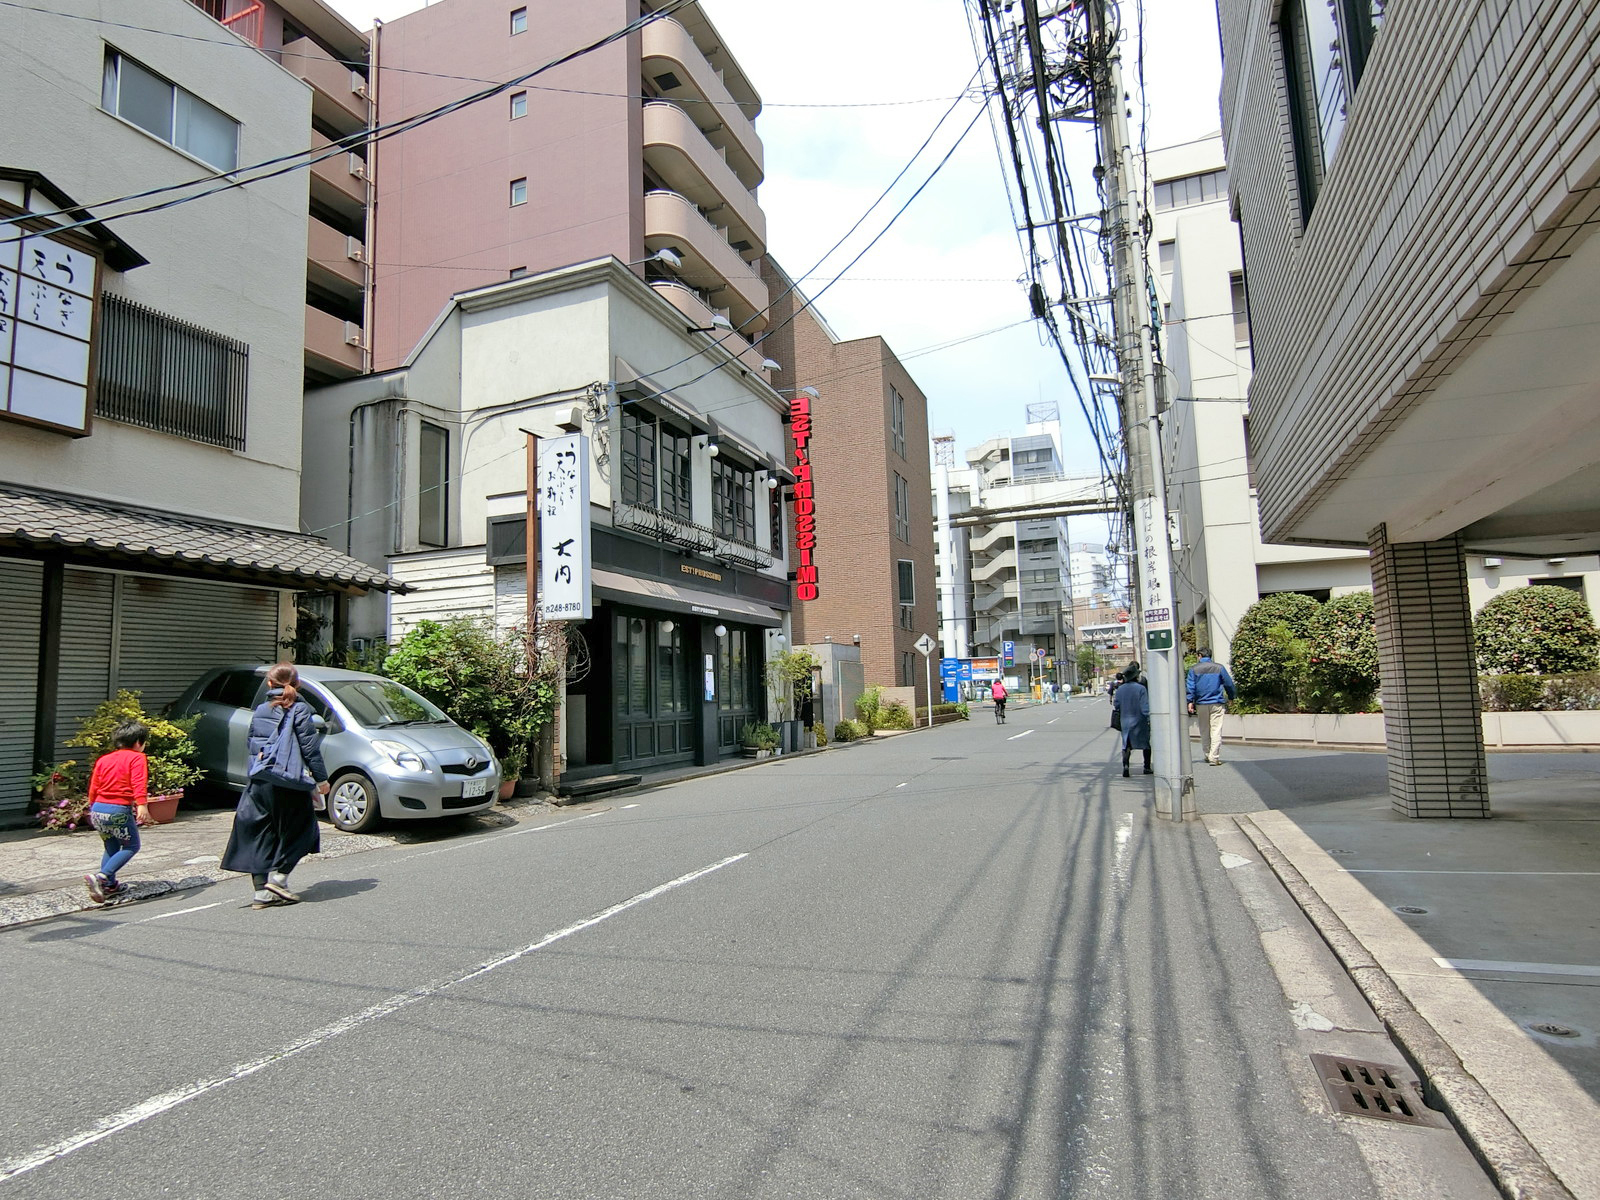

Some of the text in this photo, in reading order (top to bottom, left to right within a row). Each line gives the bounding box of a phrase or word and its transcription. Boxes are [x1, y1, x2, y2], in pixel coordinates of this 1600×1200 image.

[31, 248, 47, 321] 天ぷら
[56, 253, 75, 327] うなぎ
[547, 471, 557, 517] お料理
[556, 452, 566, 506] 天ぷら
[565, 442, 577, 500] うなぎ
[550, 602, 581, 613] 248-8780
[1005, 642, 1012, 652] P
